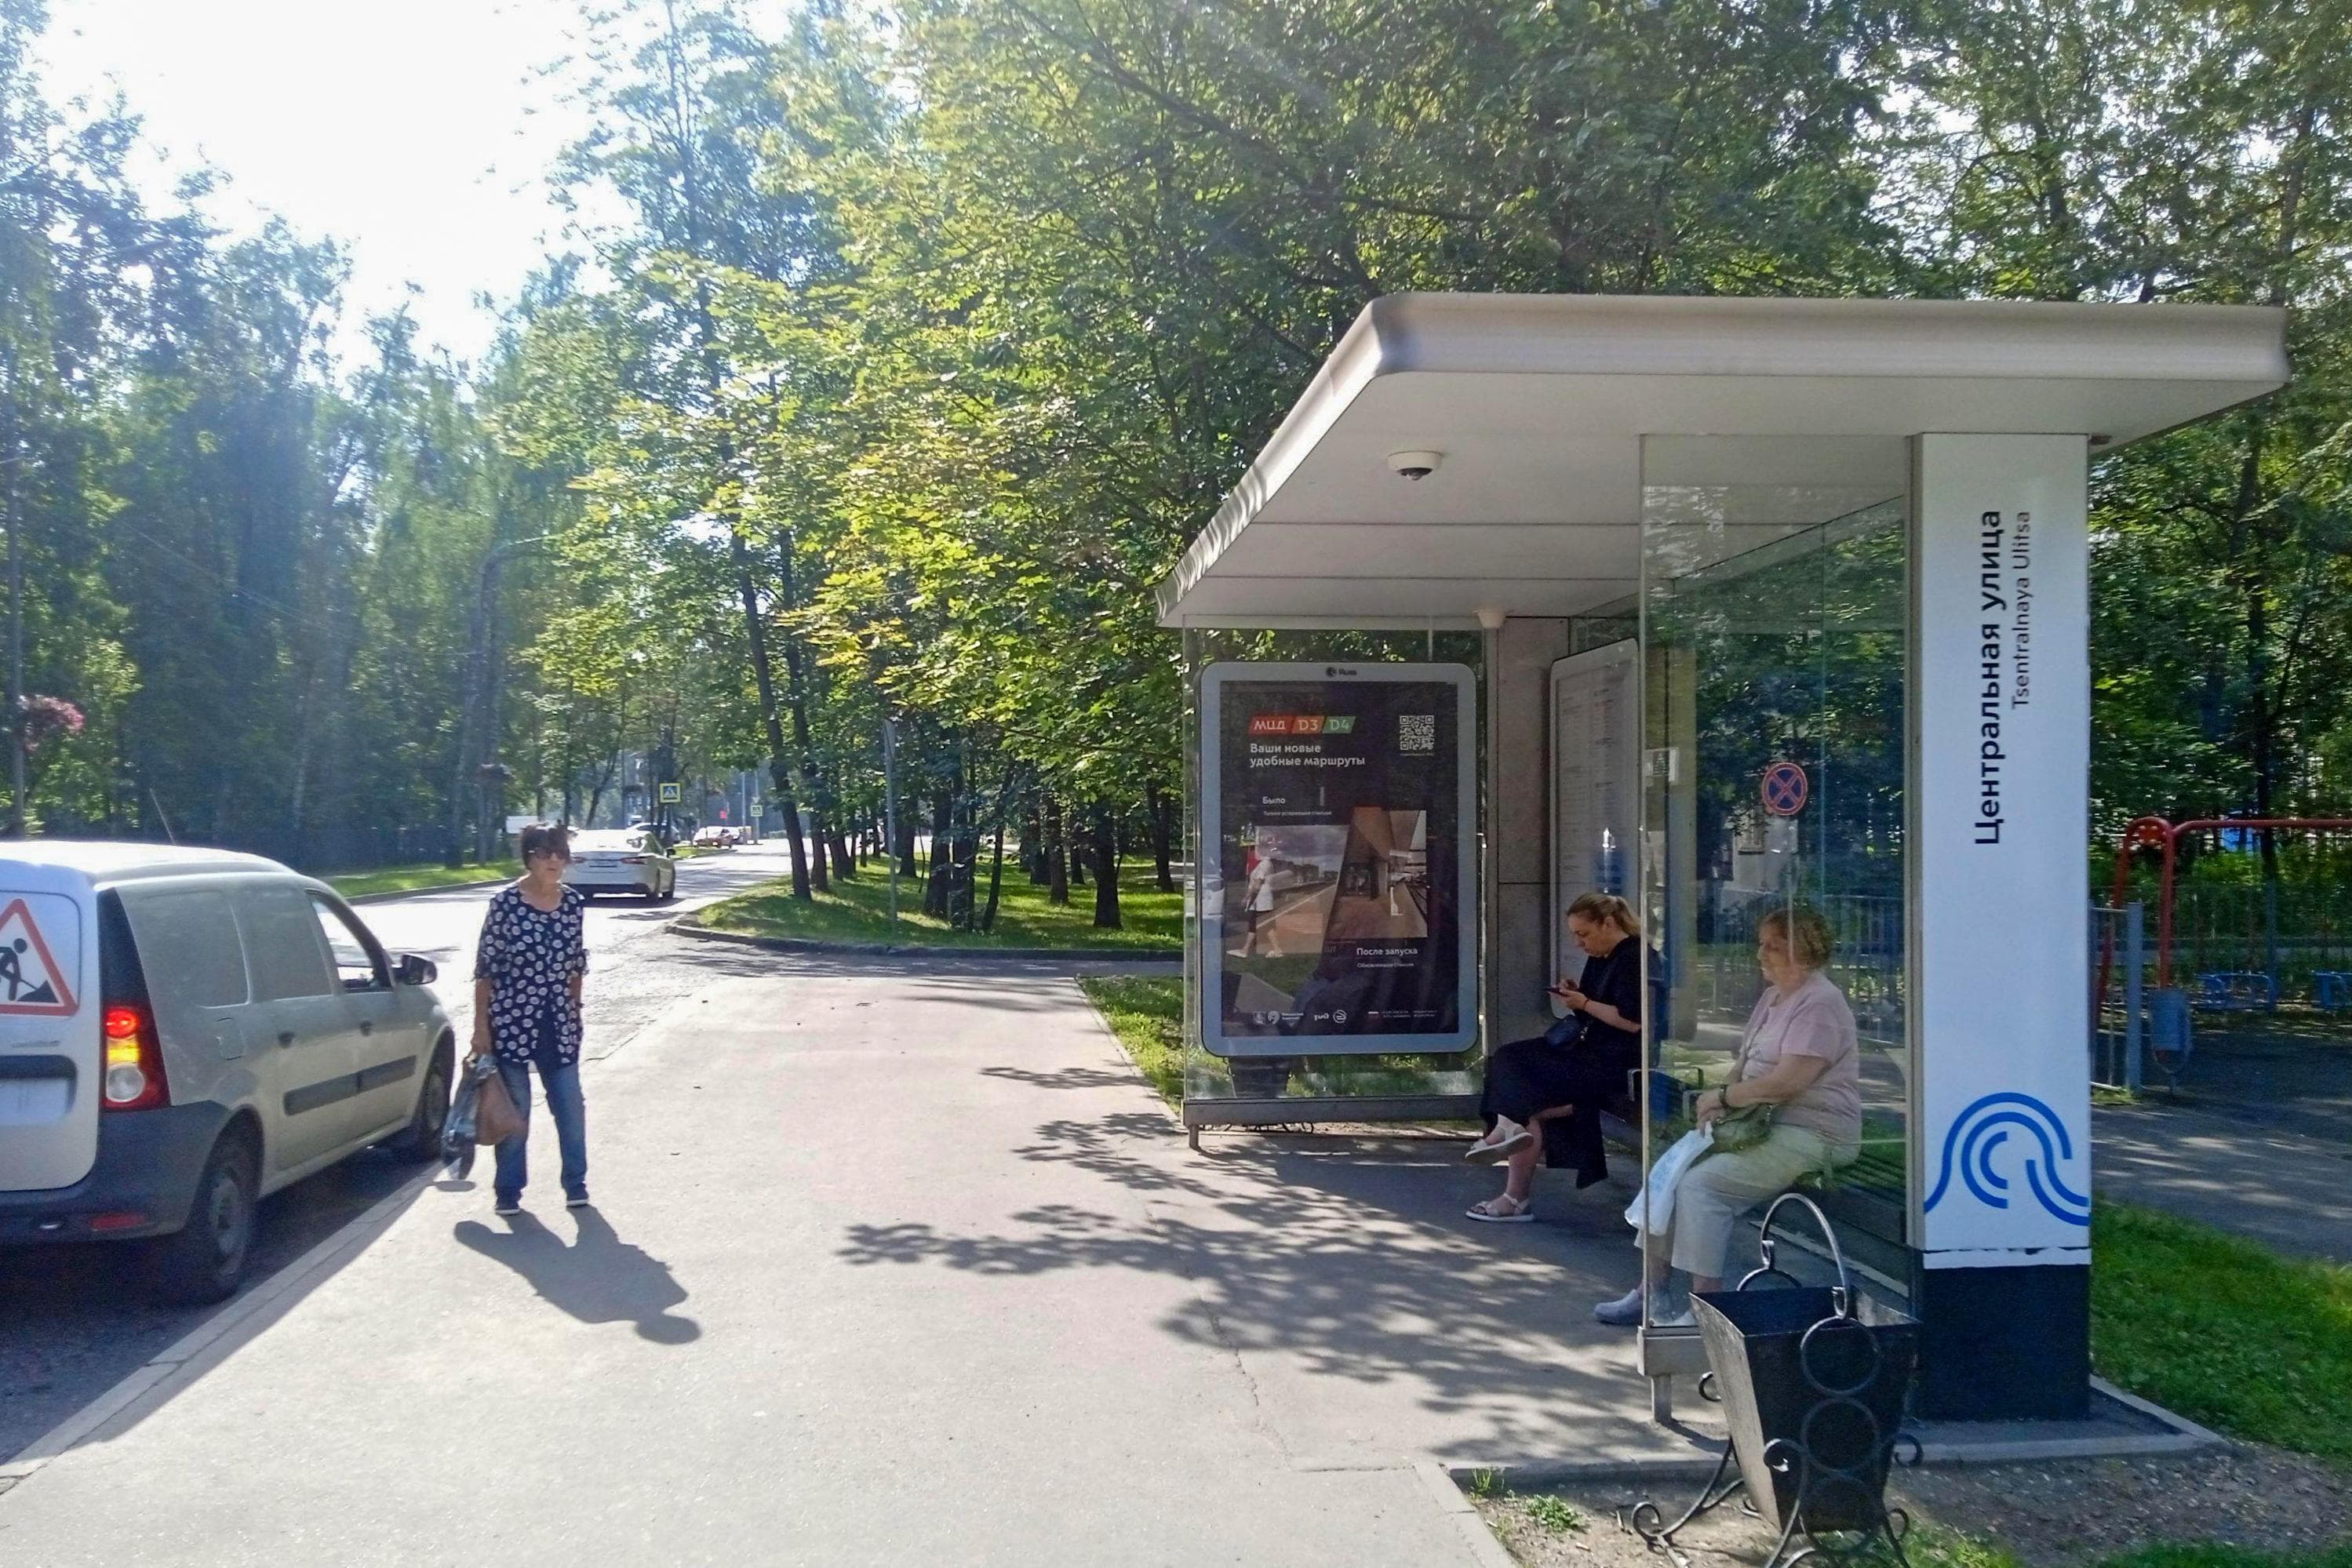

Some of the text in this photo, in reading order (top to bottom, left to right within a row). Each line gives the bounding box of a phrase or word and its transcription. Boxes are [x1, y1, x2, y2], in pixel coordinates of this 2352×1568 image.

[2011, 511, 2034, 710] Tsentralnaya Ulitsa
[1974, 511, 2007, 845] Центральная улица
[1254, 719, 1349, 731] МЦД D3 D4
[1250, 743, 1321, 753] Ваши новые
[1250, 755, 1365, 768] удобные маршруты
[1262, 796, 1286, 805] Было
[1385, 948, 1418, 957] запуска
